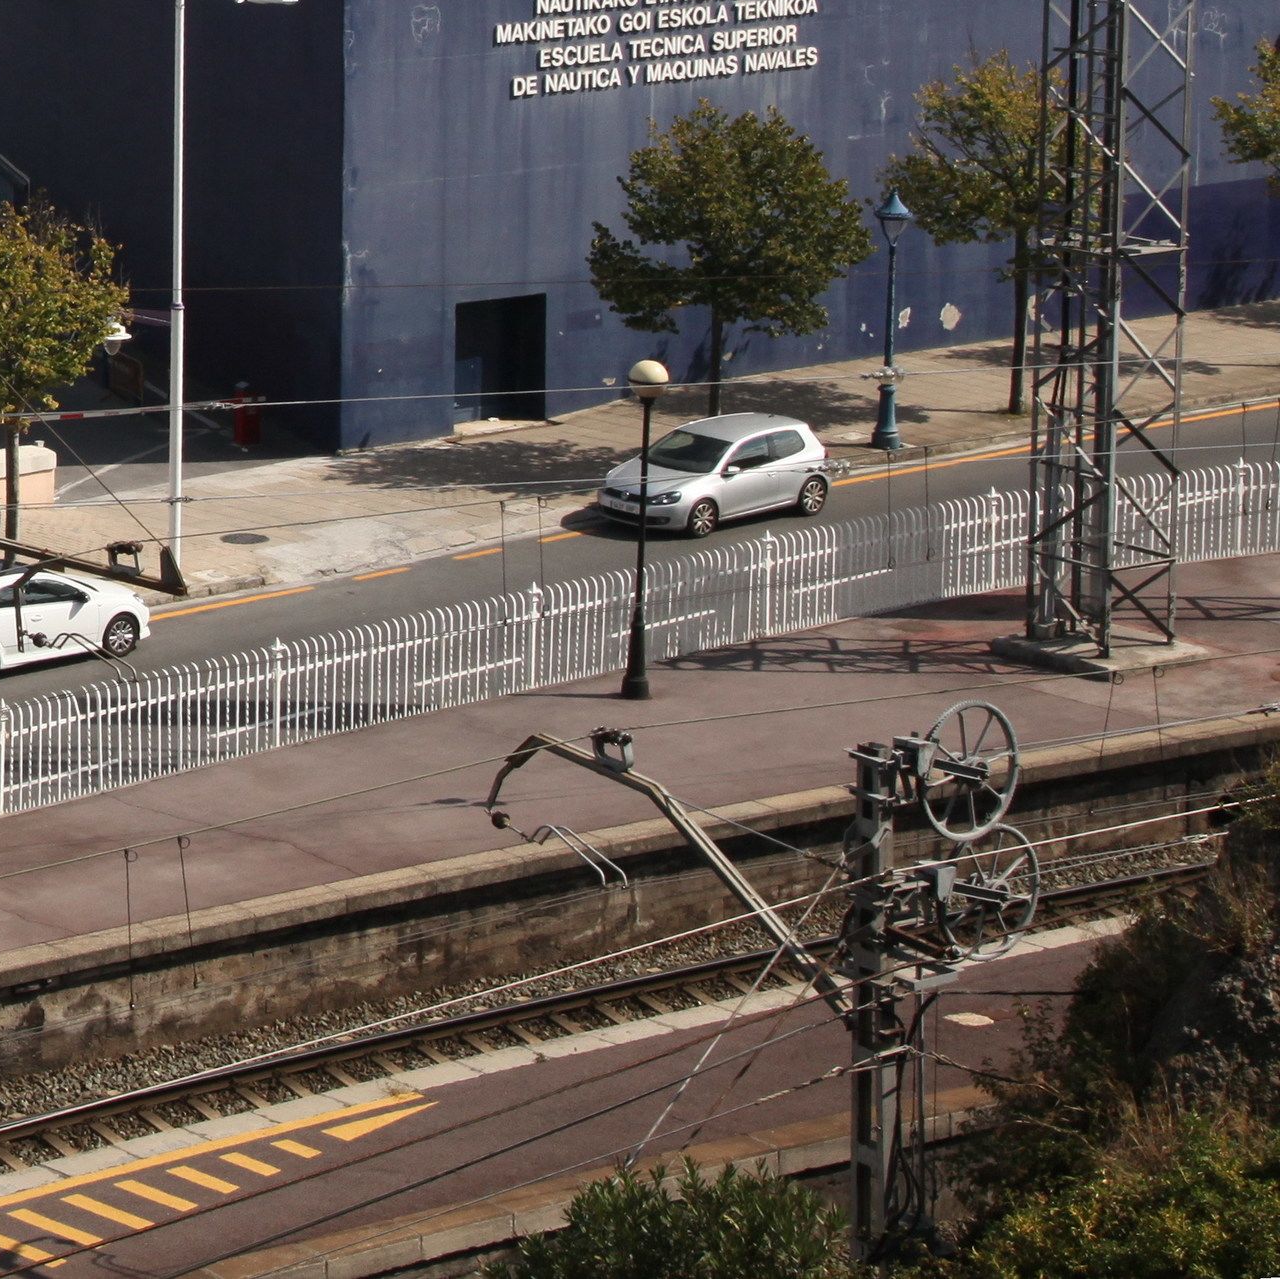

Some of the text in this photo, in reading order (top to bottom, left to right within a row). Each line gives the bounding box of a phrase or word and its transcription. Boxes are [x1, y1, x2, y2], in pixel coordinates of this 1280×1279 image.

[496, 15, 611, 43] MAKINETAKO
[619, 11, 651, 32] GOI
[658, 5, 728, 29] ESKOLA
[540, 25, 798, 68] ESCUELA TECNICA SUPERIOR
[513, 47, 818, 97] DE NAUTICA Y MAQUINAS NAVALES
